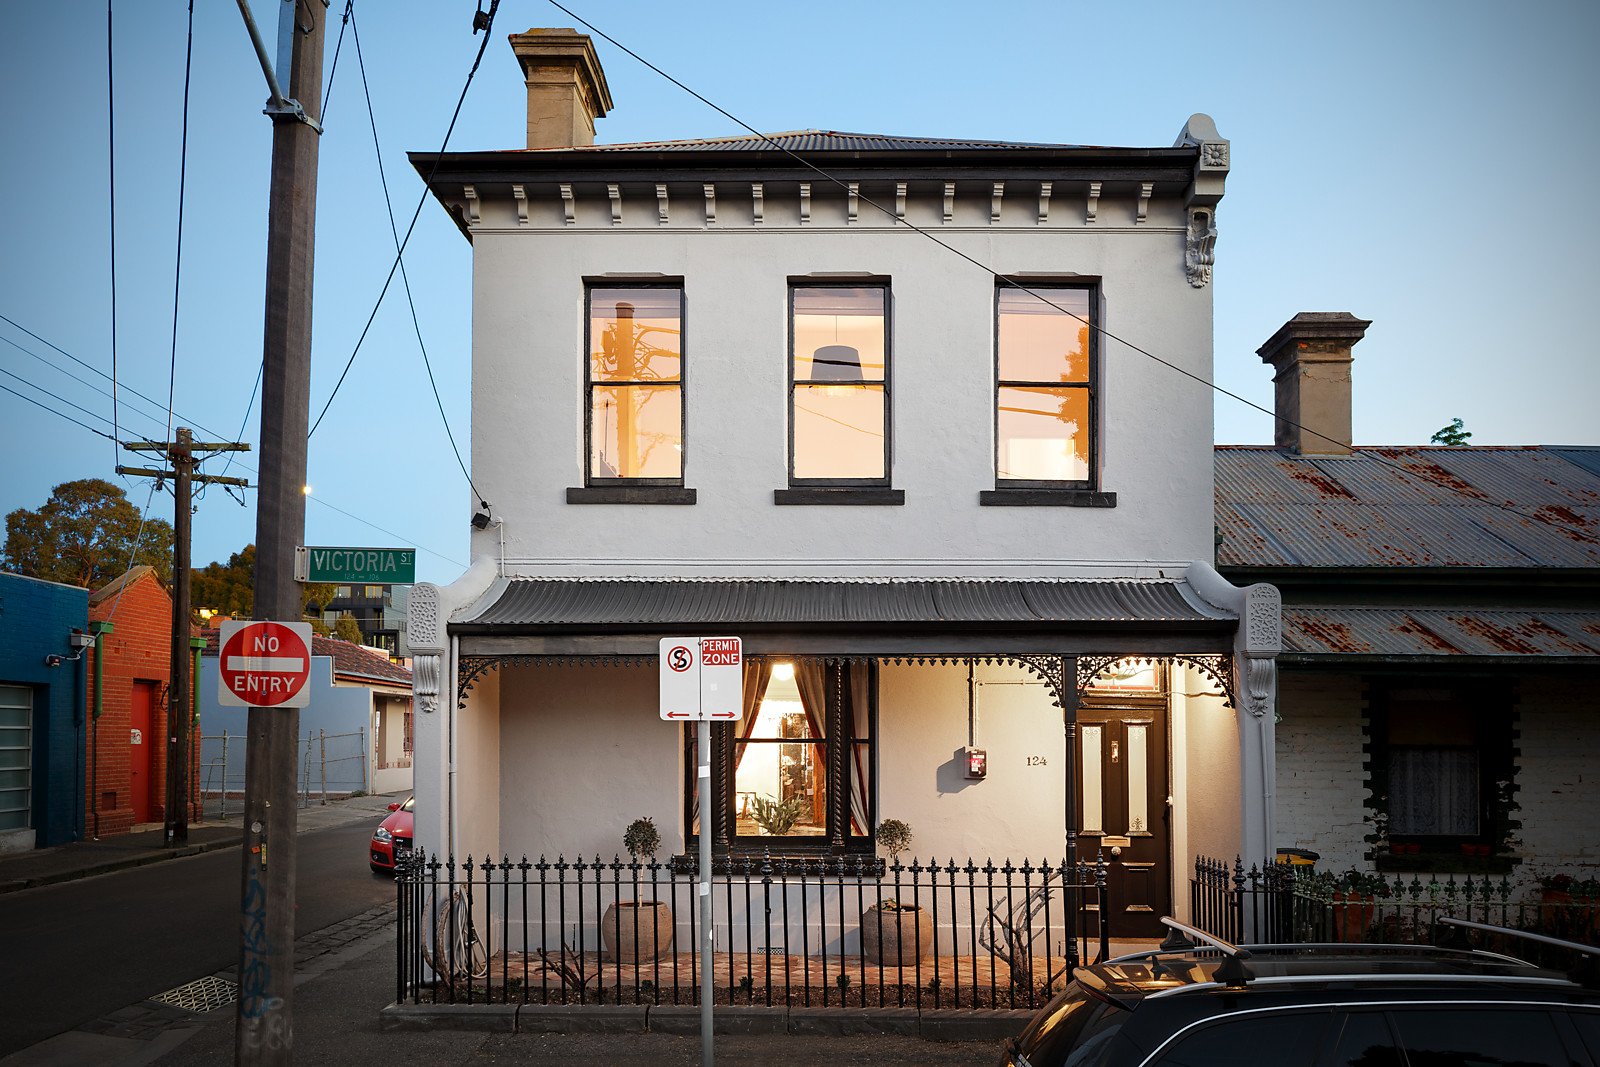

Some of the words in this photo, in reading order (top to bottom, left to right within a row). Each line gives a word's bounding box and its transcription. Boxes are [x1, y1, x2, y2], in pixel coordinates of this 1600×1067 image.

[313, 550, 397, 572] VICTORIA
[400, 552, 413, 563] ST
[254, 636, 280, 653] NO
[702, 640, 739, 651] PERMIT
[673, 649, 688, 669] S
[702, 653, 739, 664] ZONE
[234, 675, 296, 693] ENTRY
[1026, 755, 1048, 767] 124
